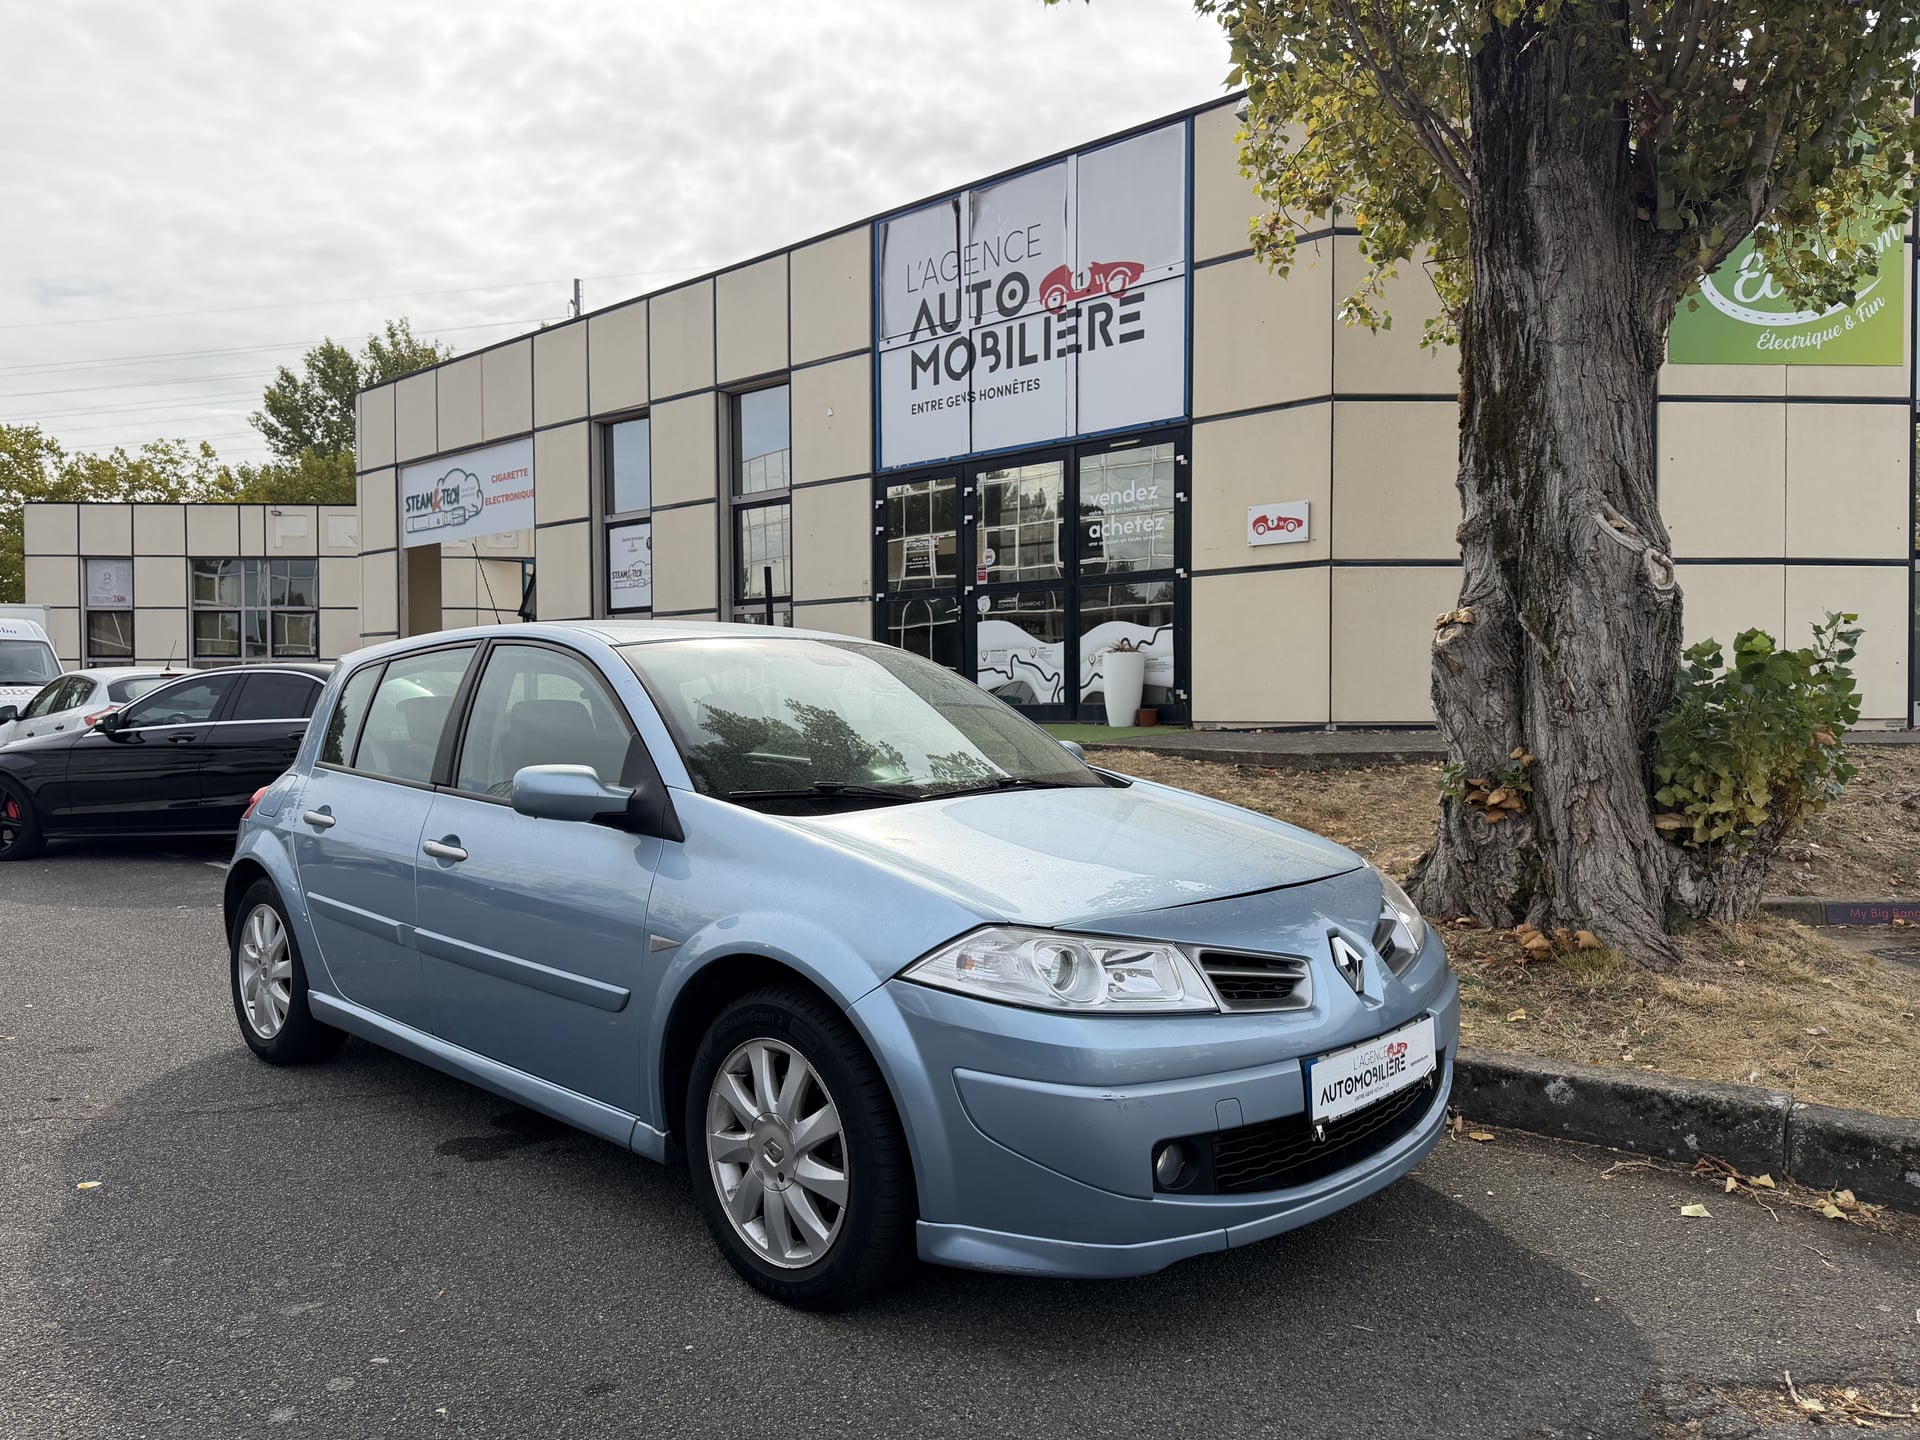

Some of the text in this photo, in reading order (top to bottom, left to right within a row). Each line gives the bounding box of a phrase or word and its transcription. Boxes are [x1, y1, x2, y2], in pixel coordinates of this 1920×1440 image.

[906, 223, 1042, 293] L'AGENCE
[909, 271, 1030, 342] AUTO
[1756, 296, 1885, 351] Électrique & Fun
[911, 378, 1041, 415] ENTRE GENS HONNÊTES
[491, 468, 528, 484] CIGARETTE
[485, 488, 536, 506] ELECTRONIQUE
[1090, 480, 1158, 507] vendez
[1088, 515, 1165, 539] achetez
[1850, 908, 1920, 920] My Big Bang
[1353, 1044, 1388, 1071] L'AGENCE
